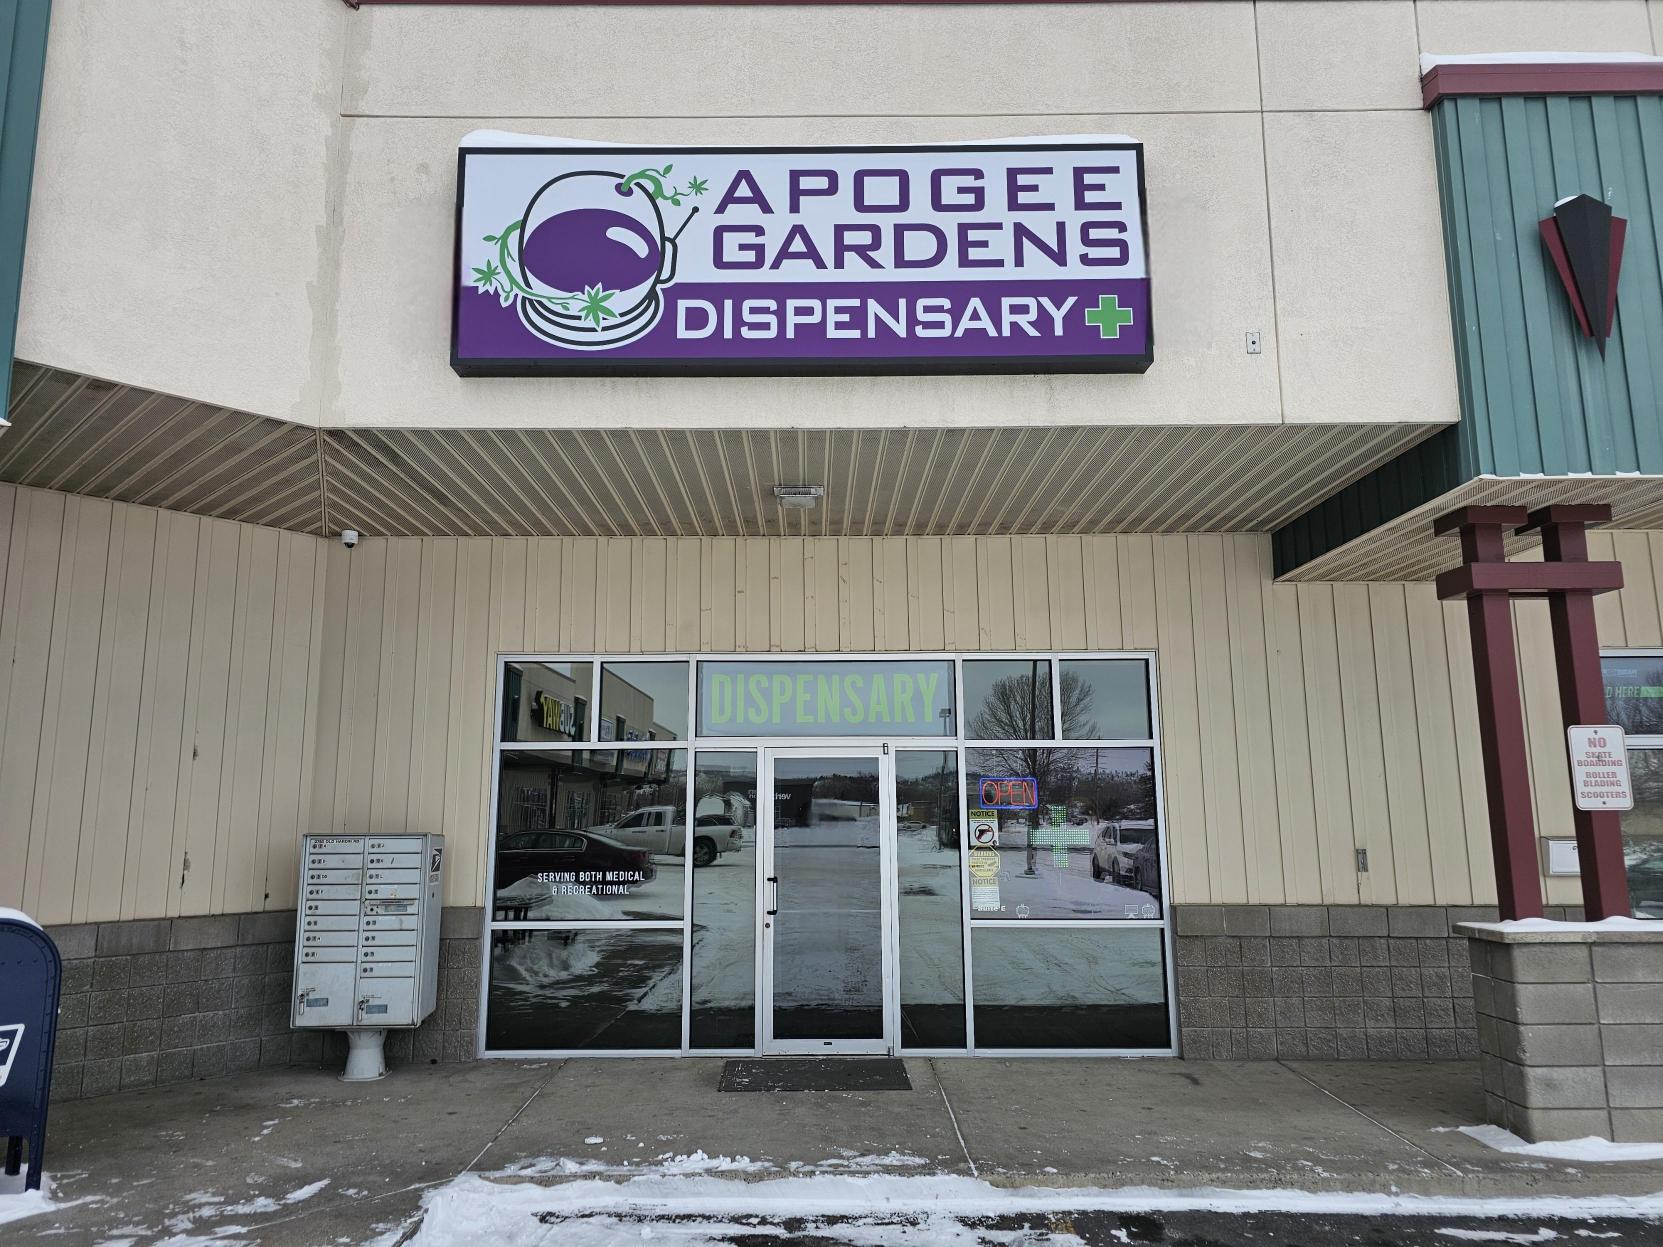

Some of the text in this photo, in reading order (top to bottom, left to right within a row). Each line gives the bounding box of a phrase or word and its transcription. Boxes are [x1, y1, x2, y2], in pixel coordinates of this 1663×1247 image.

[713, 166, 1124, 214] APOGEE
[712, 221, 1130, 269] GARDENS
[677, 296, 1078, 339] DISPENSARY
[1616, 686, 1640, 698] HERE
[711, 672, 939, 724] DISPENSARY
[1587, 737, 1607, 748] NO
[1585, 751, 1613, 759] SKATE
[1577, 759, 1623, 767] BOARDING
[1585, 771, 1617, 779] ROLLER
[1583, 779, 1622, 787] BLADING
[982, 781, 1036, 805] OPEN
[1580, 791, 1627, 799] SCOOTERS
[537, 871, 645, 882] SERVING BOTH MEDICAL
[552, 885, 630, 895] & RECREATIONAL
